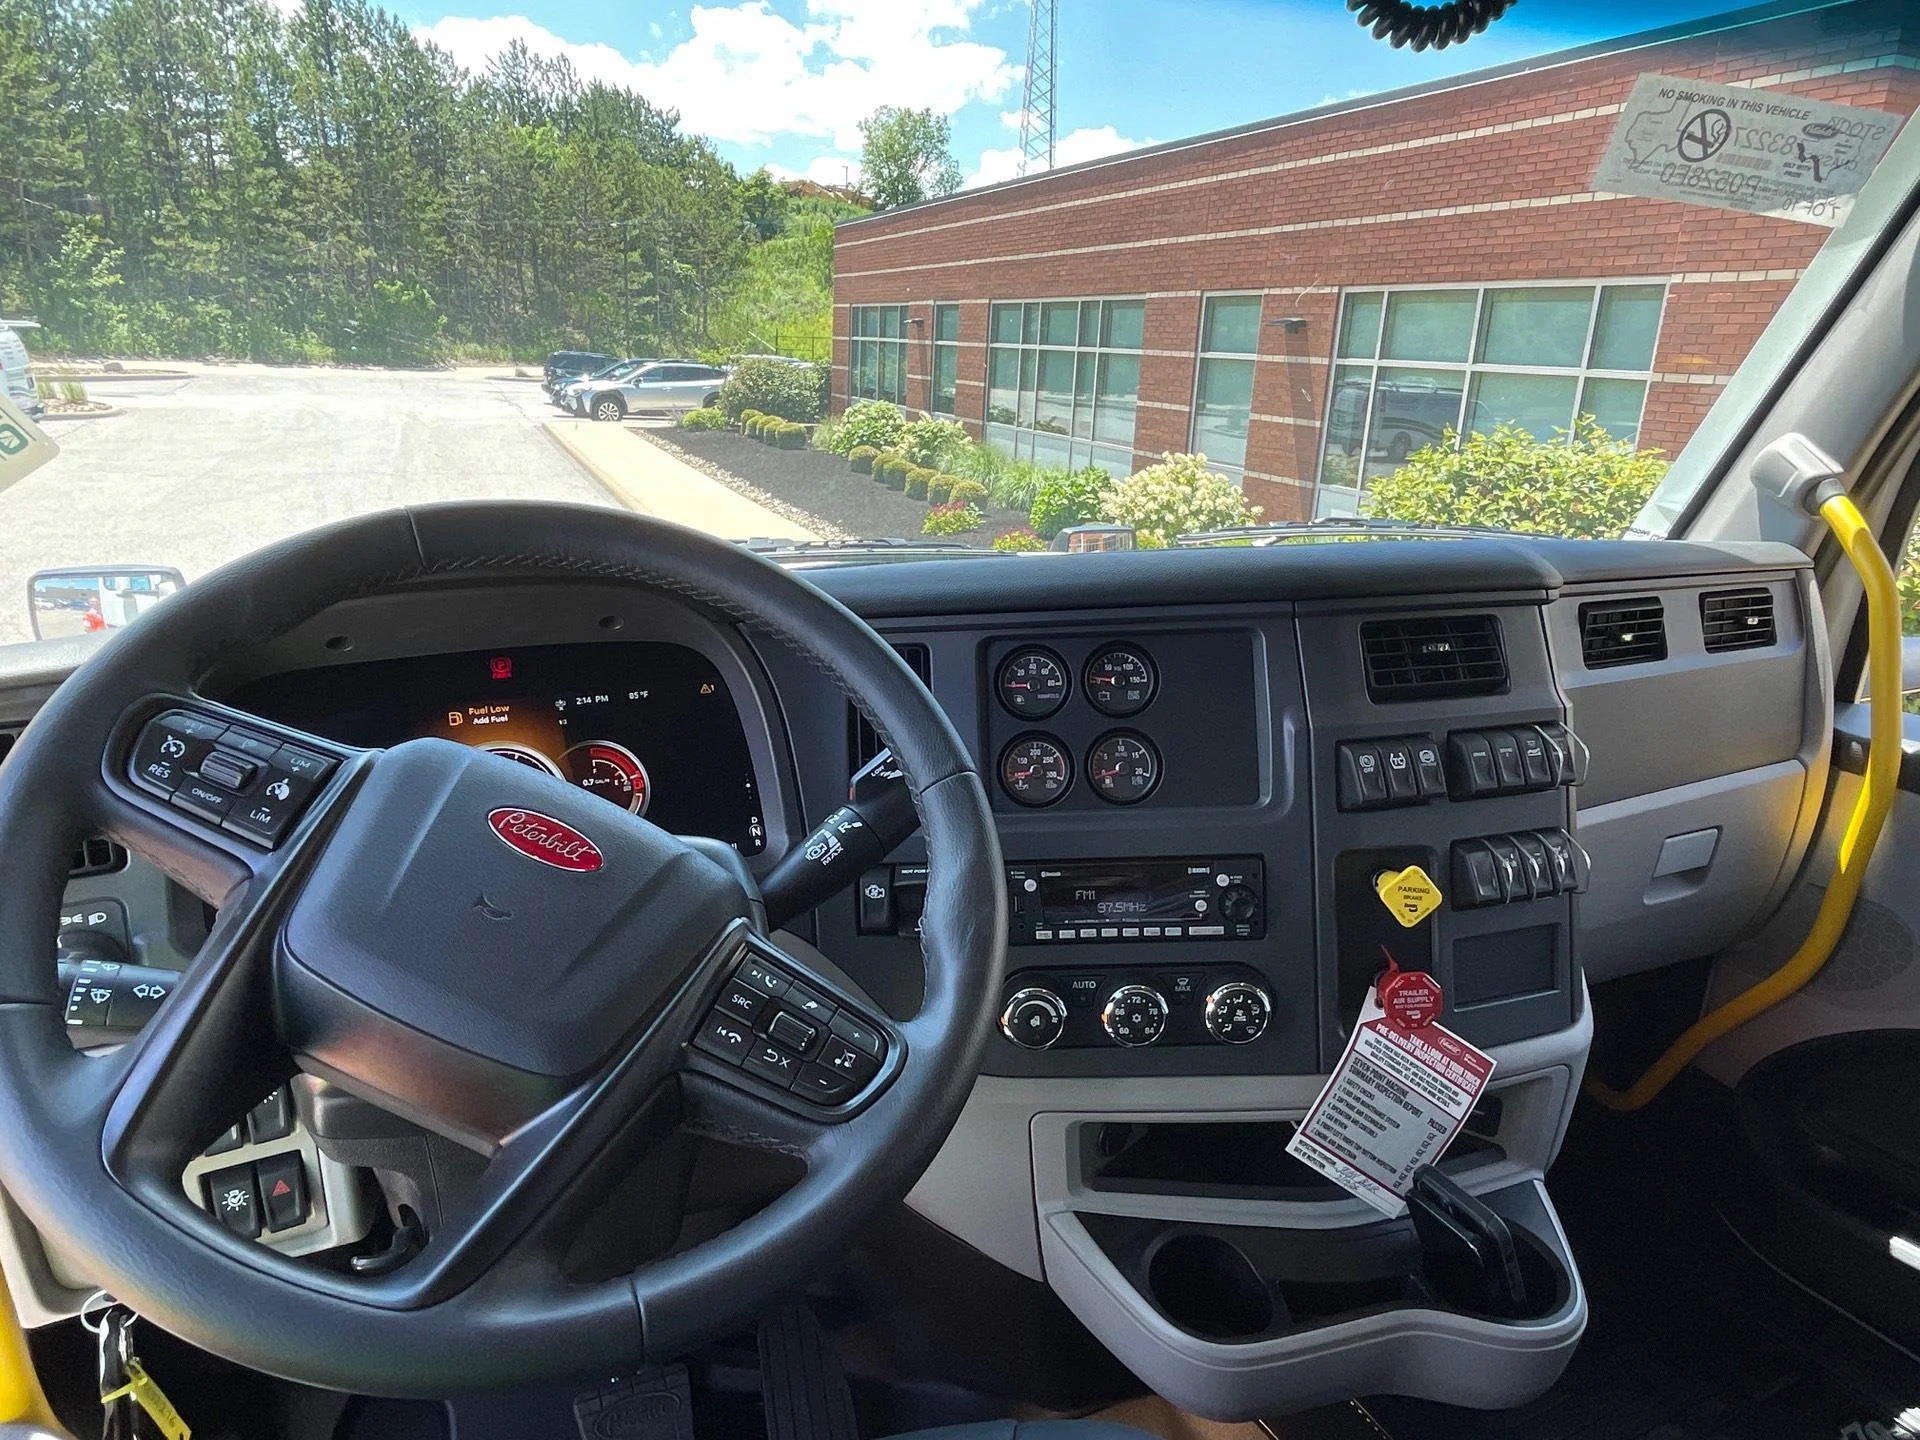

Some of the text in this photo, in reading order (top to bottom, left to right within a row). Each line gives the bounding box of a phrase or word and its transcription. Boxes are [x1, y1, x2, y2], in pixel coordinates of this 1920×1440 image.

[1658, 88, 1811, 121] NO SMOKING IN THIS VEHICLE
[1040, 667, 1049, 675] 60
[1104, 663, 1112, 671] 50
[1122, 663, 1134, 671] 100
[576, 695, 592, 706] 2:14
[595, 695, 609, 704] PM
[468, 704, 510, 716] Fuel Low
[472, 714, 509, 726] Add Fuel
[1029, 748, 1041, 756] 200
[1042, 756, 1054, 764] 250
[1392, 757, 1405, 766] TC
[148, 763, 171, 779] RES
[1135, 767, 1143, 775] 20
[582, 778, 594, 787] 0.7
[191, 787, 223, 805] ON/OFF
[249, 808, 272, 824] LIM
[498, 811, 597, 862] Peterbilt
[755, 839, 761, 847] R
[1398, 885, 1430, 894] PARKING
[1072, 981, 1097, 989] AUTO
[1399, 988, 1429, 997] TRAILER
[731, 994, 753, 1010] SRC
[1131, 996, 1141, 1004] 72
[1393, 996, 1435, 1005] AIR SUPPLY
[1374, 1022, 1416, 1054] PRE-DELIVERY
[1411, 1046, 1447, 1074] INSPECTION
[1442, 1067, 1478, 1095] CERTIFICATE
[1406, 1033, 1425, 1049] TAKE
[1425, 1045, 1443, 1062] LOOK
[1438, 1054, 1451, 1067] AT
[1446, 1060, 1464, 1076] YOUR
[1460, 1069, 1482, 1087] TRUCK
[1351, 1056, 1410, 1098] SEVEN-POINT MACHINE
[1347, 1064, 1423, 1119] SUMMARY INSPECTION REPORT
[1426, 1116, 1448, 1135] PASSED
